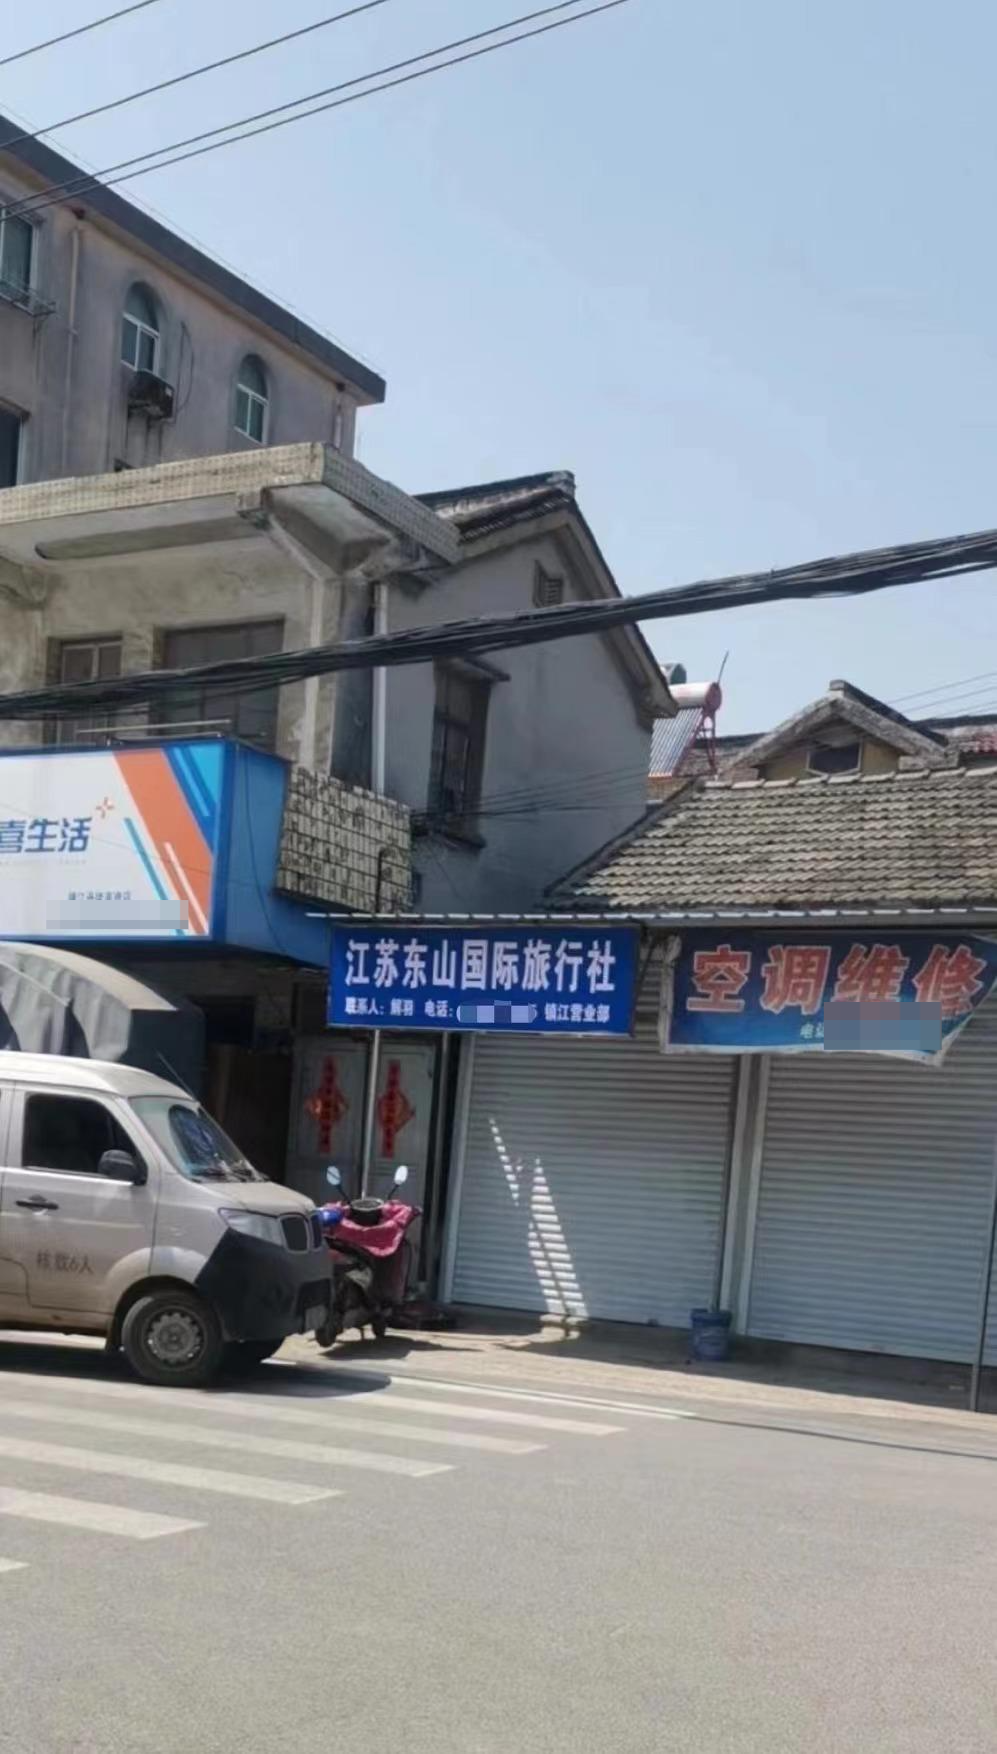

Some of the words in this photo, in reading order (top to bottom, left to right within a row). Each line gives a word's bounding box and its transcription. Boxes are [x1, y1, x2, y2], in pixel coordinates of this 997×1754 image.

[345, 938, 615, 994] 江苏东山国际旅行社
[686, 944, 987, 1015] 空调维修
